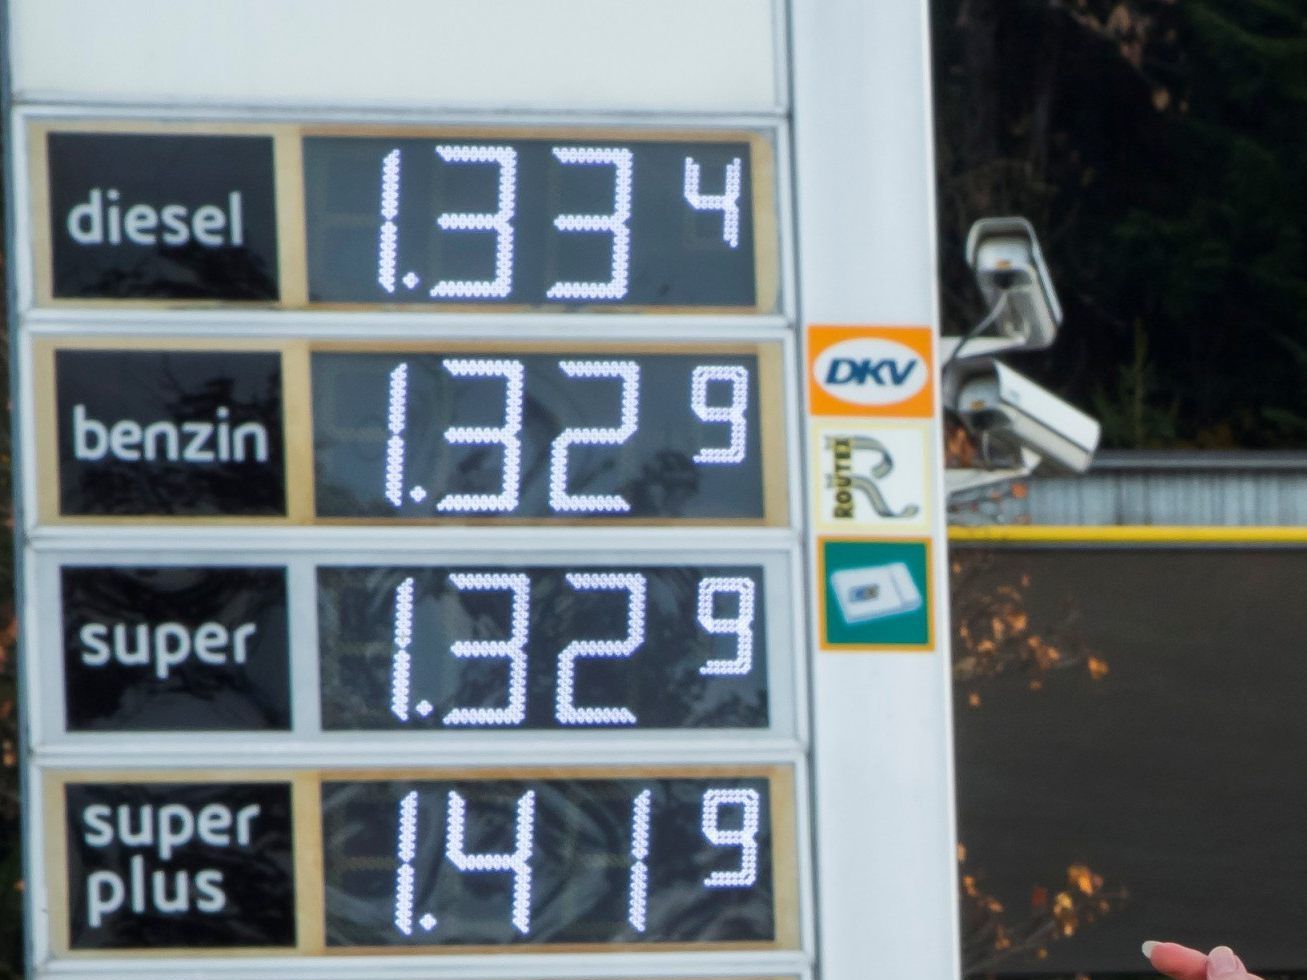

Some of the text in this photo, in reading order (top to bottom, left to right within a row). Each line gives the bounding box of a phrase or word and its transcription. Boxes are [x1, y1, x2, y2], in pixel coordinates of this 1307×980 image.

[68, 189, 243, 245] diesel
[824, 357, 917, 386] DKV
[73, 404, 267, 461] benzin
[80, 622, 256, 678] super
[84, 803, 260, 861] super
[87, 856, 226, 927] plus
